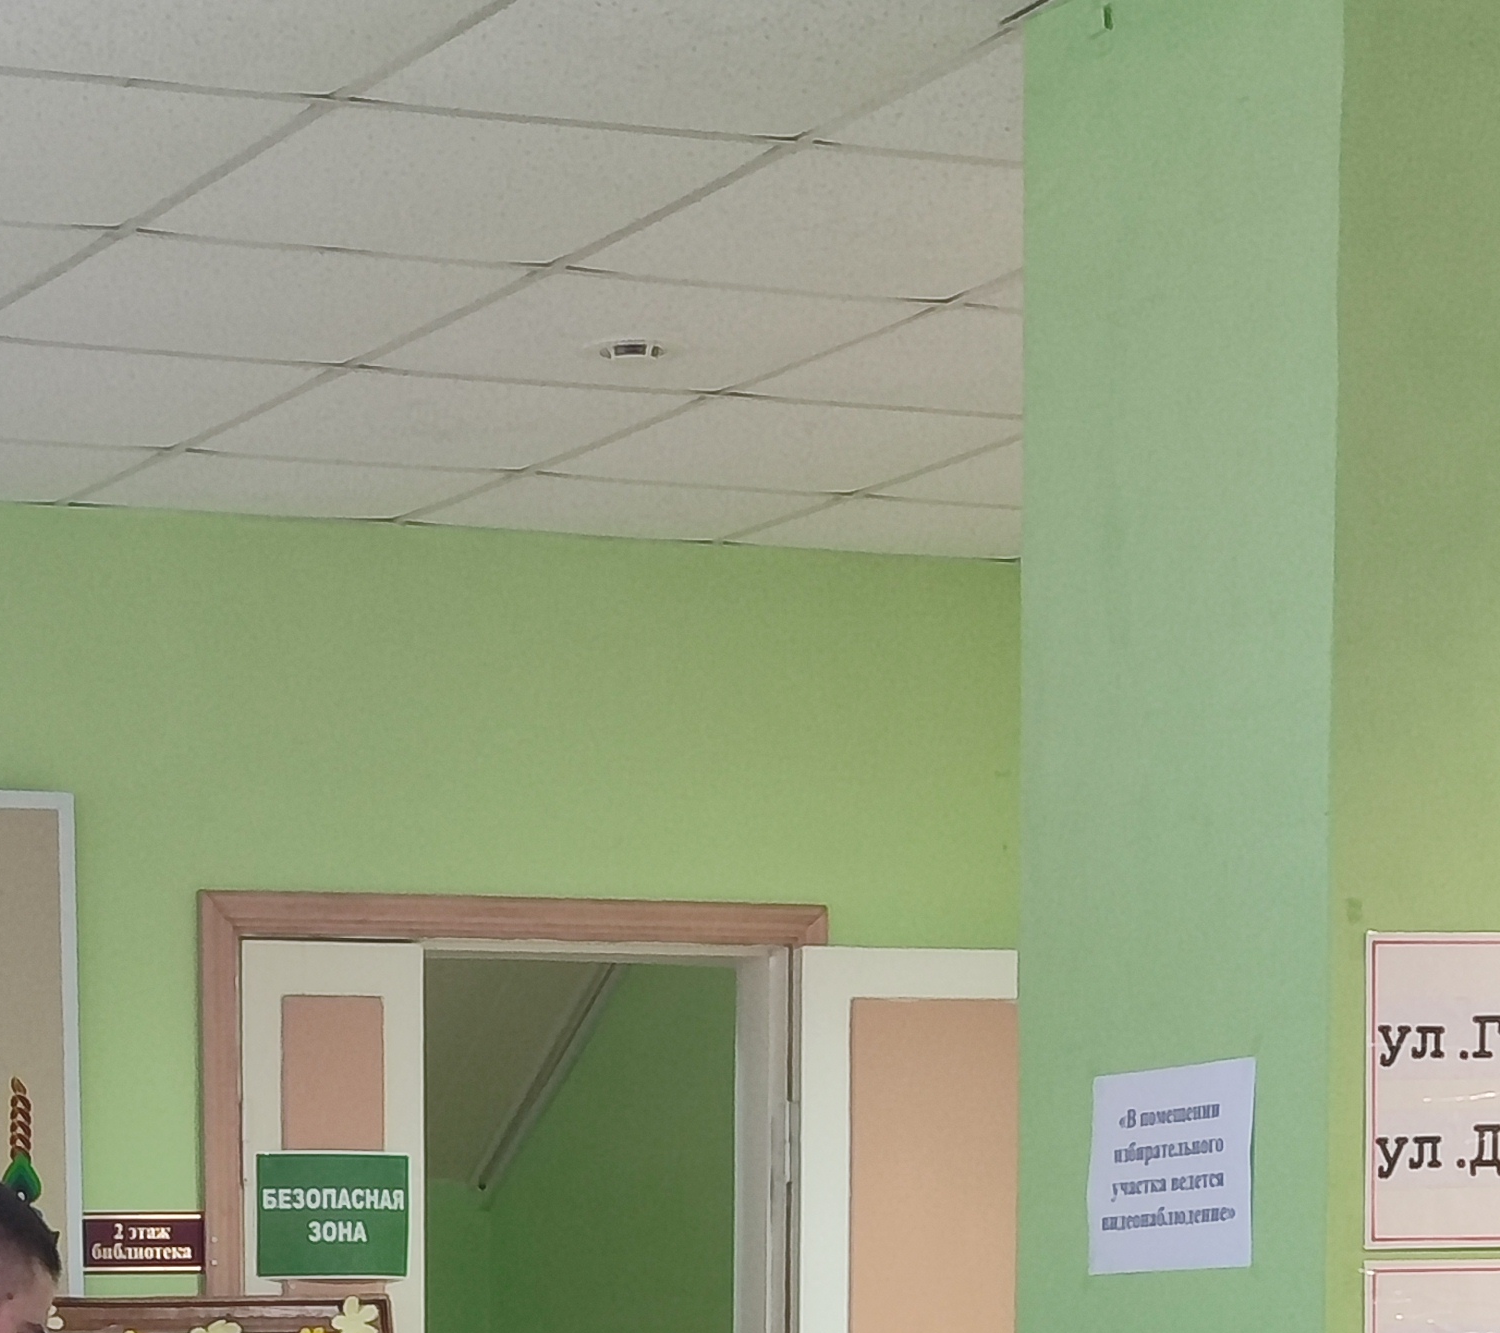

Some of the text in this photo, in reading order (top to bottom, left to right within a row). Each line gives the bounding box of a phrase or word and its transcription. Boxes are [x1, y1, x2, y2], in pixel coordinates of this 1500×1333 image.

[1139, 1103, 1221, 1127] помещении
[1113, 1137, 1224, 1166] избирательного
[261, 1187, 405, 1212] БЕЗОПАСНАЯ
[1110, 1172, 1224, 1203] участка ведется
[112, 1223, 172, 1241] 2 этаж
[306, 1219, 368, 1243] ЗОНА
[90, 1243, 193, 1261] библиотека
